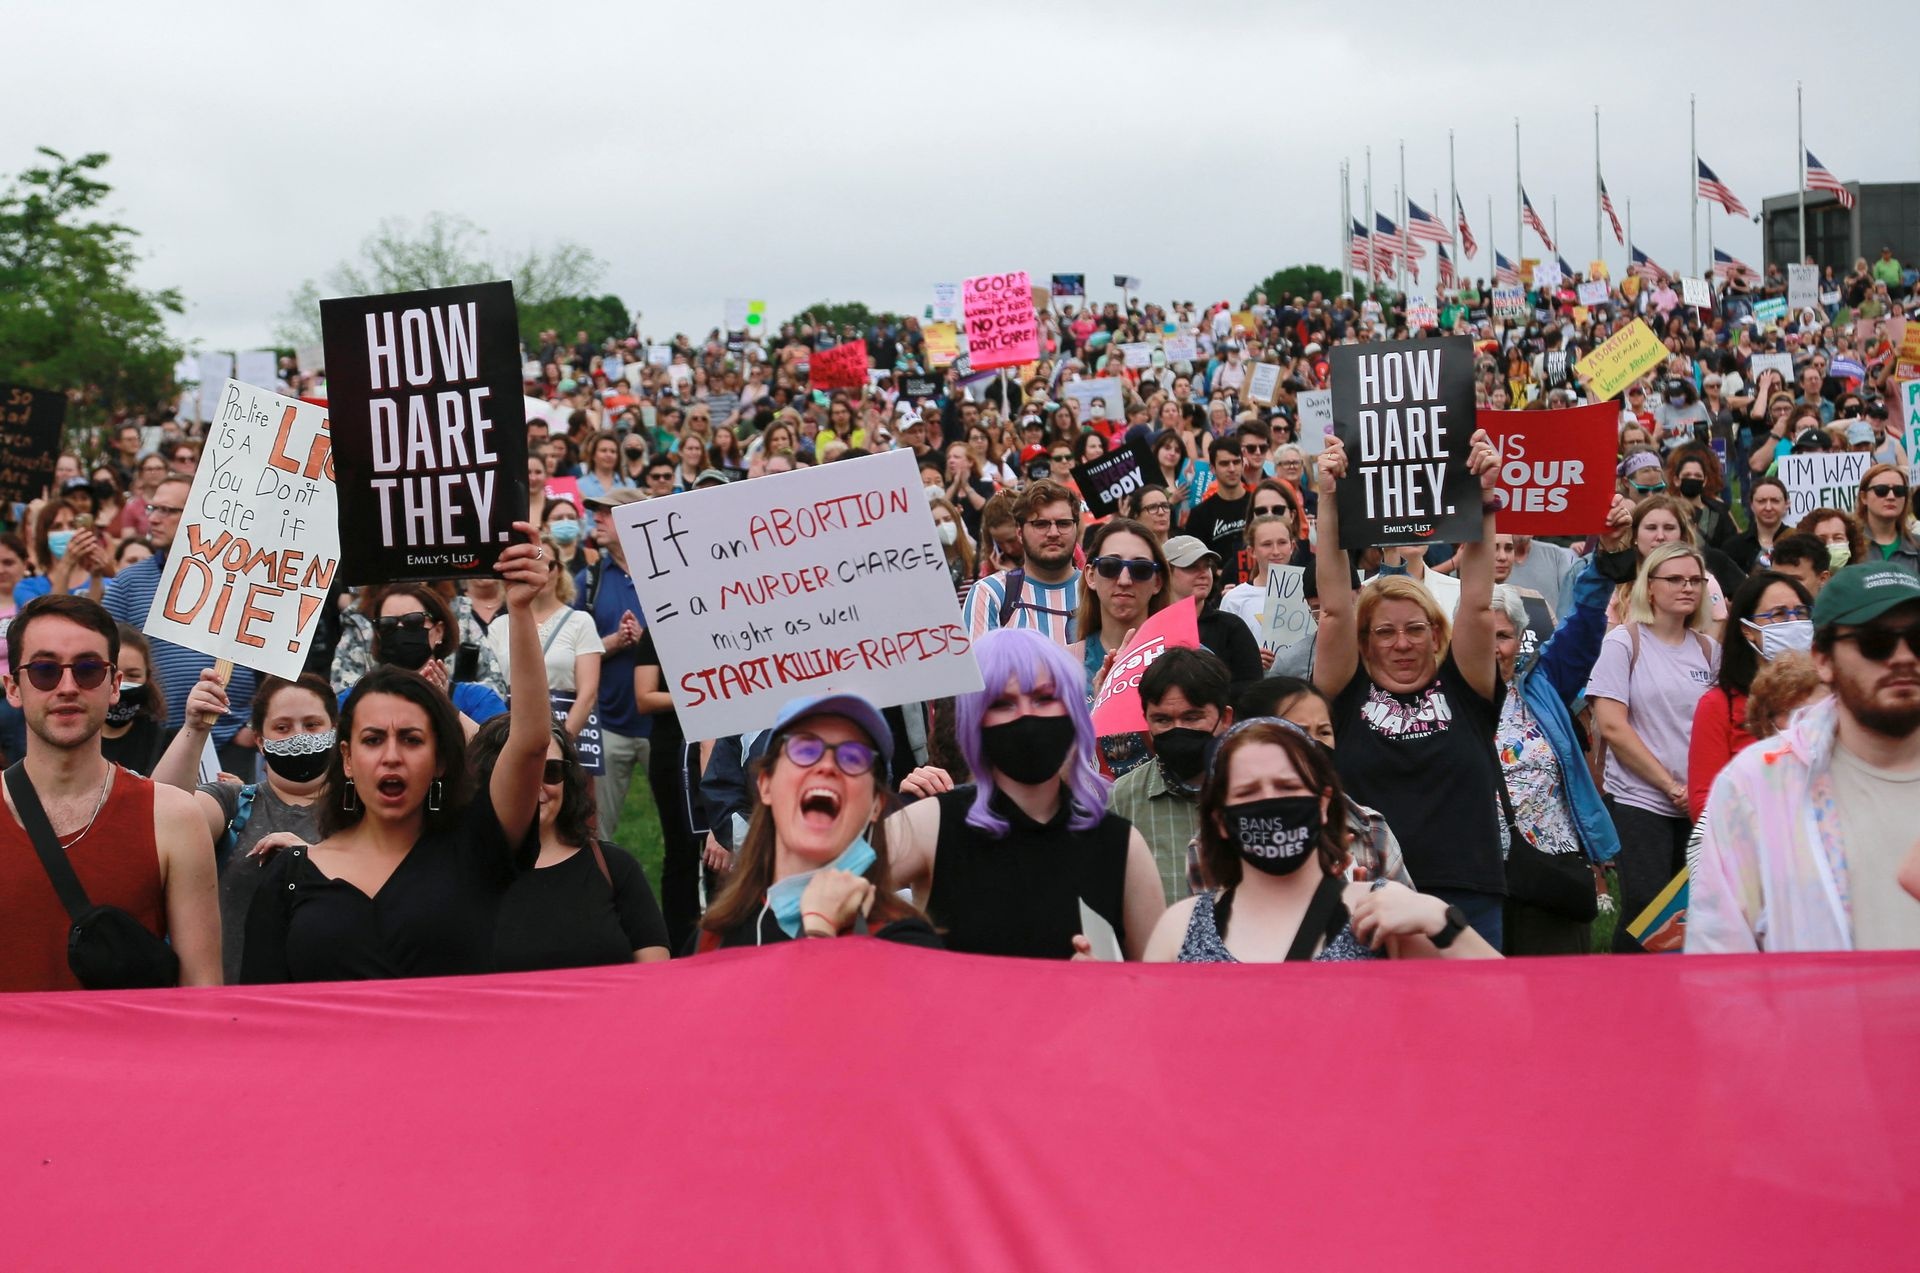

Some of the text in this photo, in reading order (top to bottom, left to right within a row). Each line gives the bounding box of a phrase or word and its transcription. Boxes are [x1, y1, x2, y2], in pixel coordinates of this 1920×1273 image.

[365, 302, 478, 389] HOW
[972, 318, 993, 335] NO
[1358, 348, 1441, 405] HOW
[369, 386, 498, 472] DARE
[1359, 405, 1450, 462] DARE
[1485, 434, 1526, 459] NS
[209, 449, 243, 494] You
[1100, 466, 1145, 504] BODY
[1359, 462, 1456, 519] THEY.
[1501, 460, 1585, 487] OUR
[1787, 454, 1864, 486] I'M WAY
[202, 491, 305, 541] Care if
[370, 470, 510, 547] THEY.
[1494, 487, 1570, 513] DIES
[631, 487, 909, 580] If an ABORTION
[1415, 523, 1432, 532] LIST
[187, 523, 336, 590] WOMEN
[452, 553, 475, 564] LIST
[689, 596, 708, 616] a
[720, 566, 834, 610] MURDER
[838, 543, 944, 583] CHARGE,
[711, 604, 860, 651] might as well
[680, 623, 971, 708] START KILLING RAPISTS
[1239, 817, 1283, 831] BANS
[1240, 826, 1310, 845] OFF OUR
